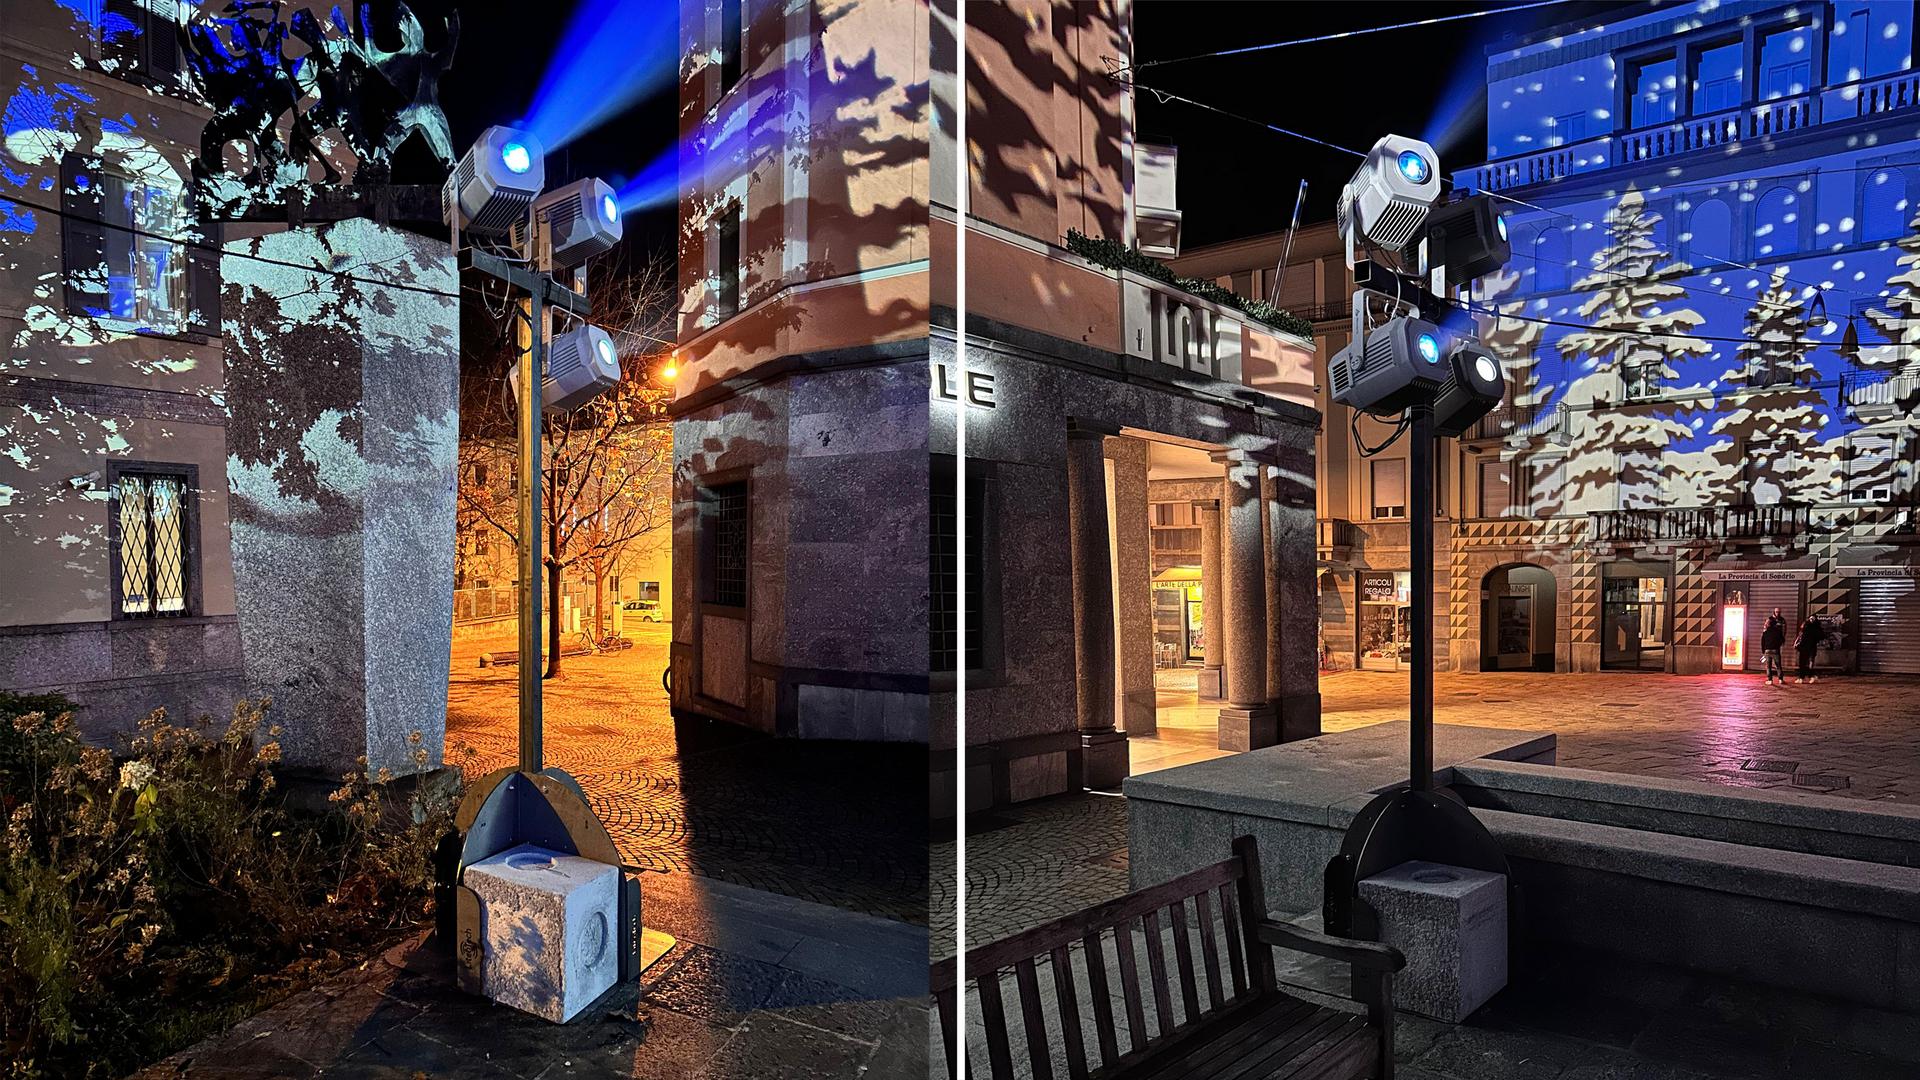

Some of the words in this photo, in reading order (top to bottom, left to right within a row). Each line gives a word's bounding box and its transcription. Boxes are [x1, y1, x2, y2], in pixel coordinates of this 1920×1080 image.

[1857, 568, 1866, 576] La
[1868, 568, 1902, 576] Provincia
[1363, 578, 1392, 587] ARTICOLI
[1364, 587, 1391, 595] REGALO
